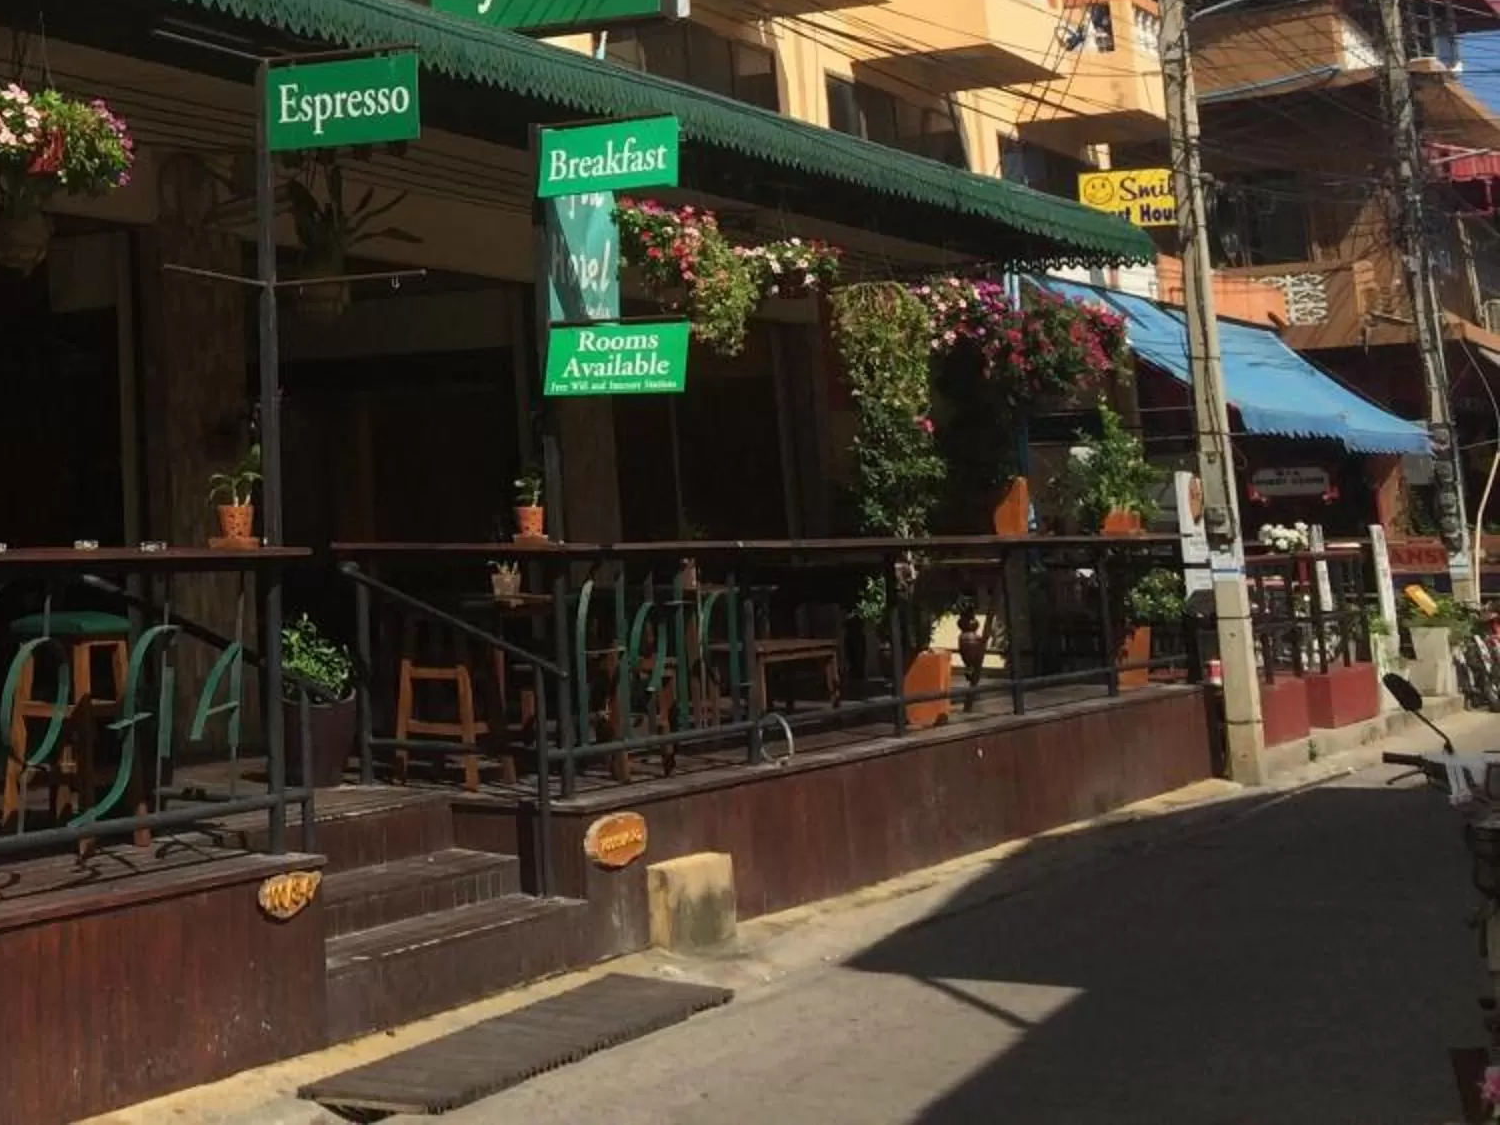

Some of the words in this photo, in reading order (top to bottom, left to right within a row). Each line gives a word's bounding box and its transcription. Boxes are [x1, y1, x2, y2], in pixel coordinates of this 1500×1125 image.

[278, 83, 410, 135] Espresso
[548, 137, 668, 182] Breakfast
[1119, 174, 1175, 201] Smil
[577, 331, 660, 352] Rooms
[562, 352, 671, 378] Available
